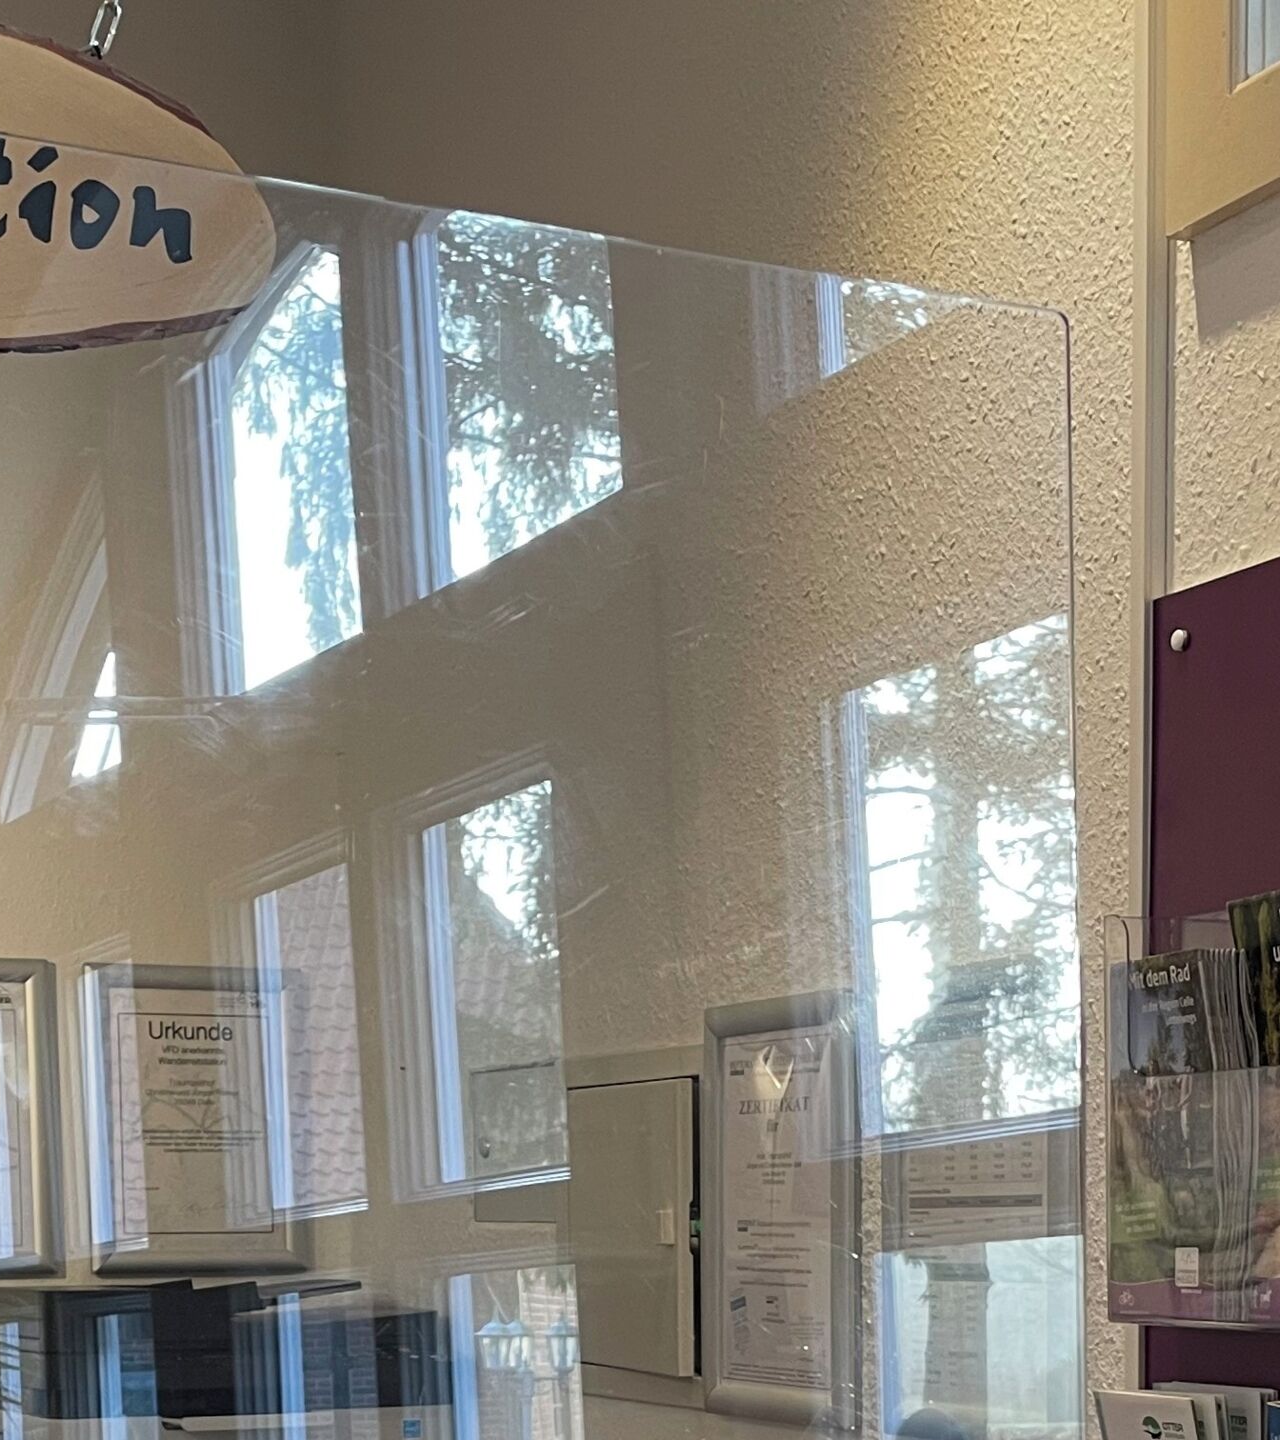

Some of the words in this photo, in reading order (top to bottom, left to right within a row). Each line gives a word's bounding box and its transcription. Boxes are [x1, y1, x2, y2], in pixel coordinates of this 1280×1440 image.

[1145, 967, 1169, 986] dem
[1170, 962, 1191, 983] Rad
[148, 1020, 233, 1041] Urkunde
